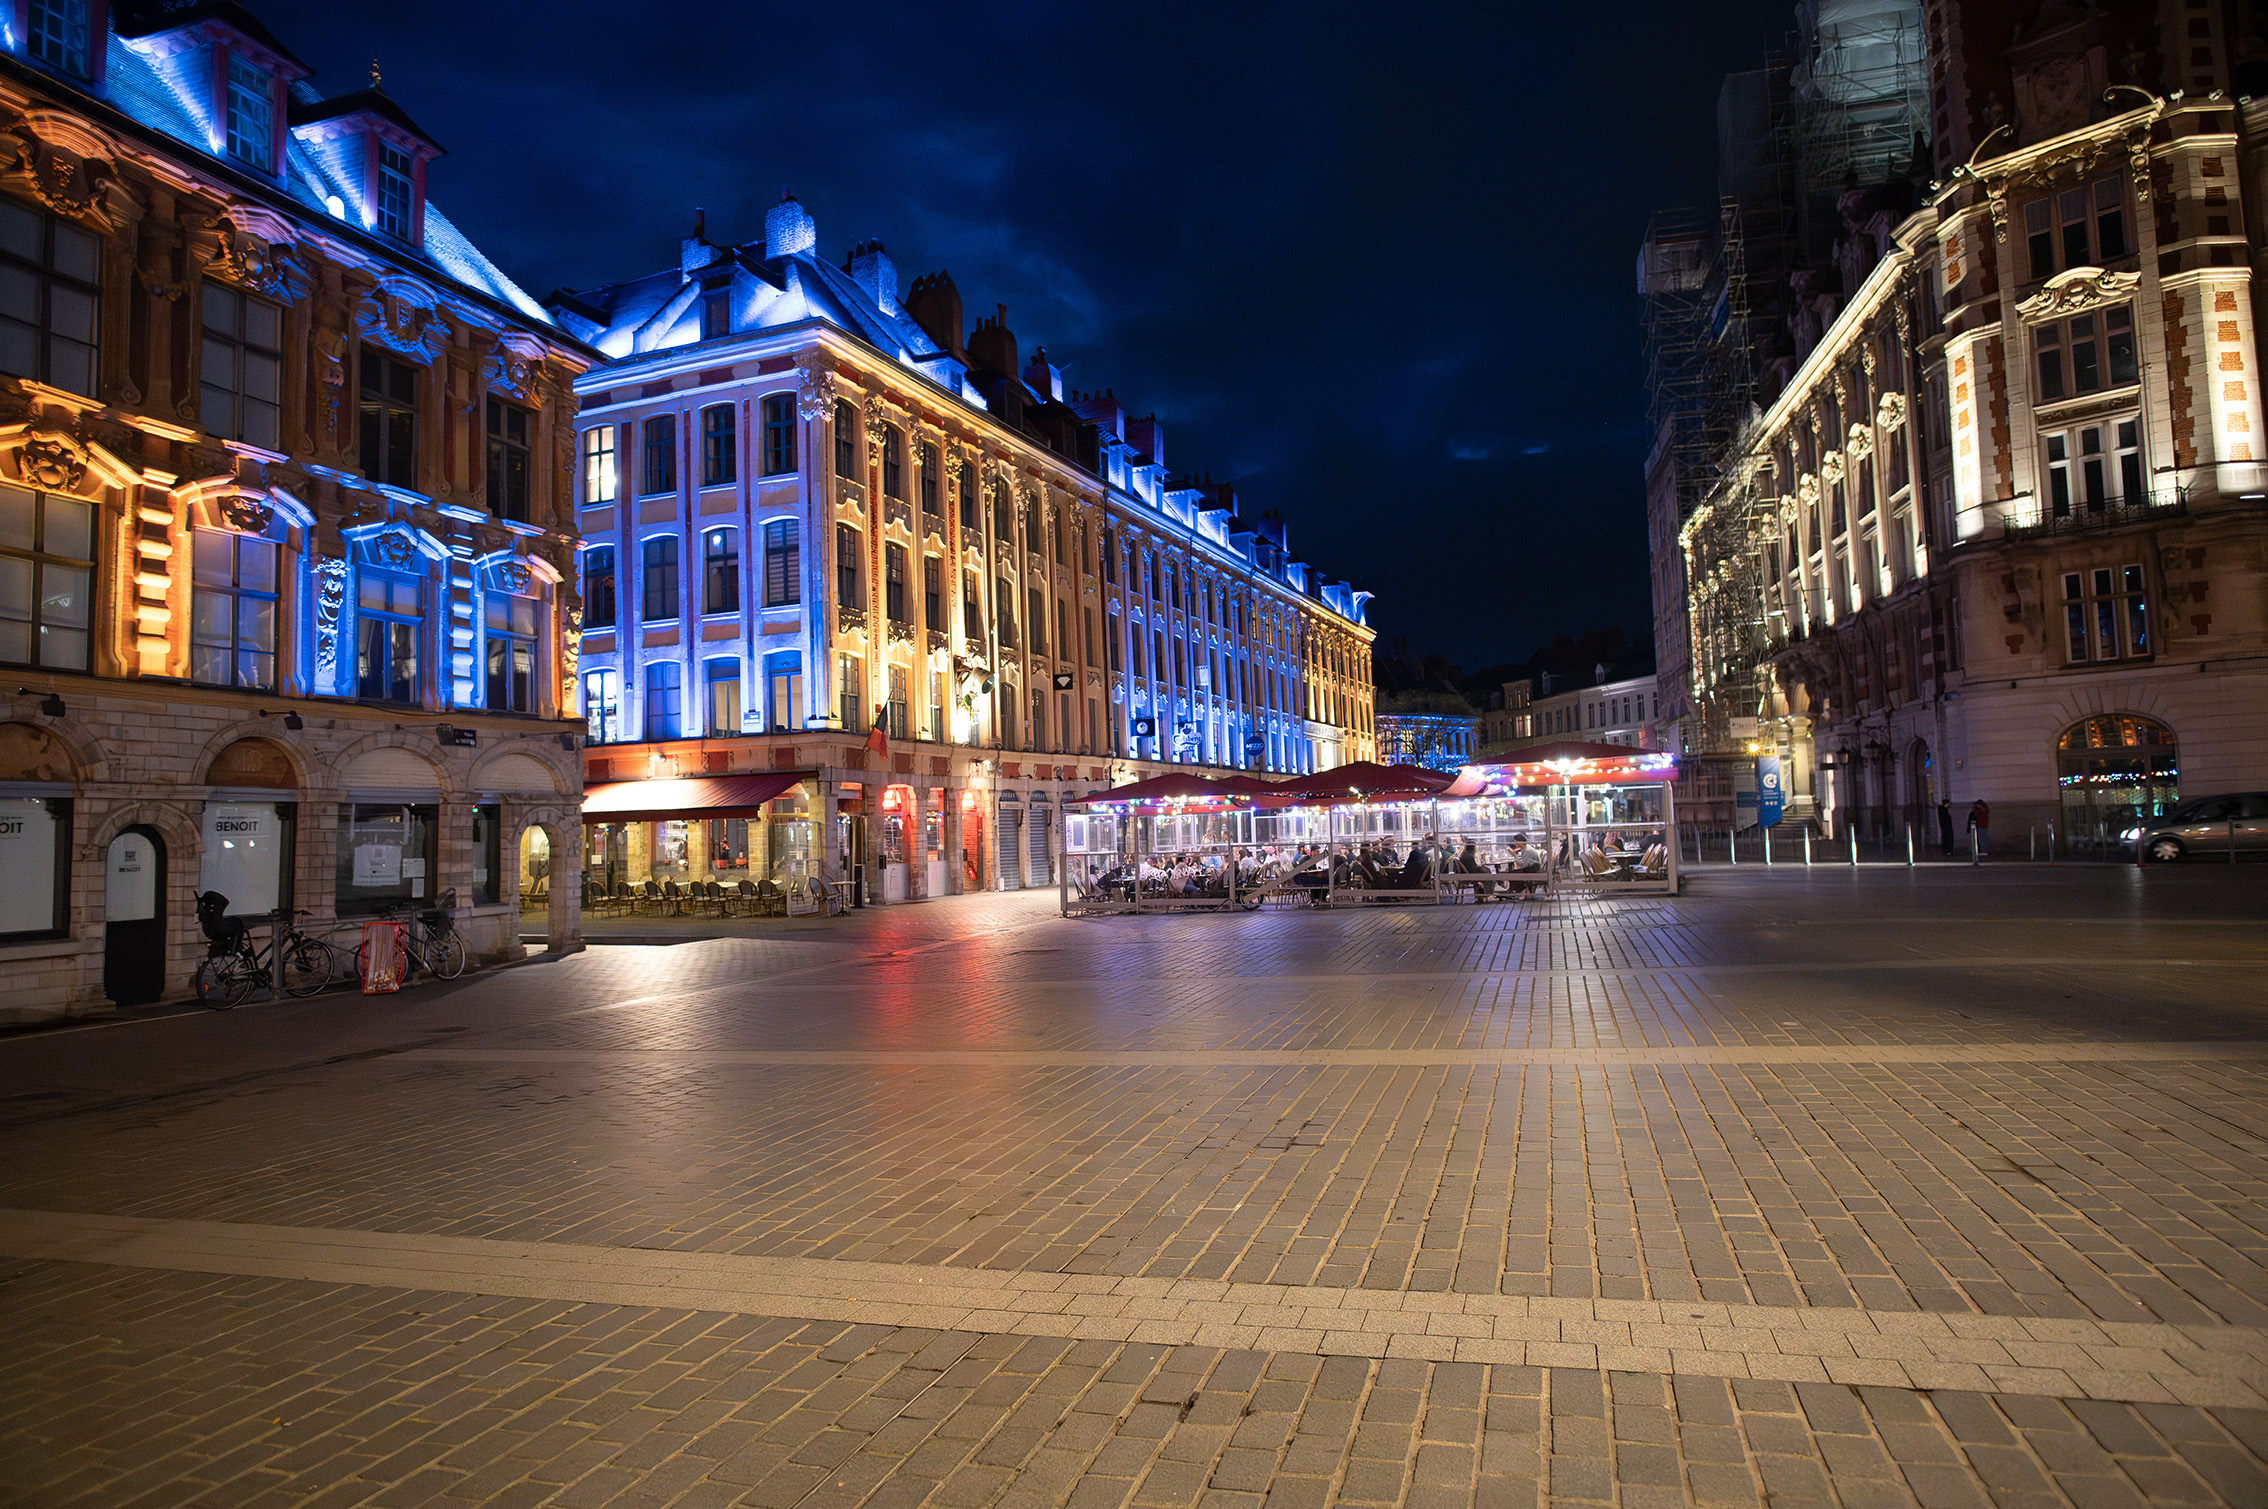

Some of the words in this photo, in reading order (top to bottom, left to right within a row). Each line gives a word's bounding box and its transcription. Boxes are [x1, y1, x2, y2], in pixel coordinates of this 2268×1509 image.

[1173, 735, 1202, 745] Carlsberg
[0, 822, 24, 833] OIT
[216, 821, 259, 831] BENOIT
